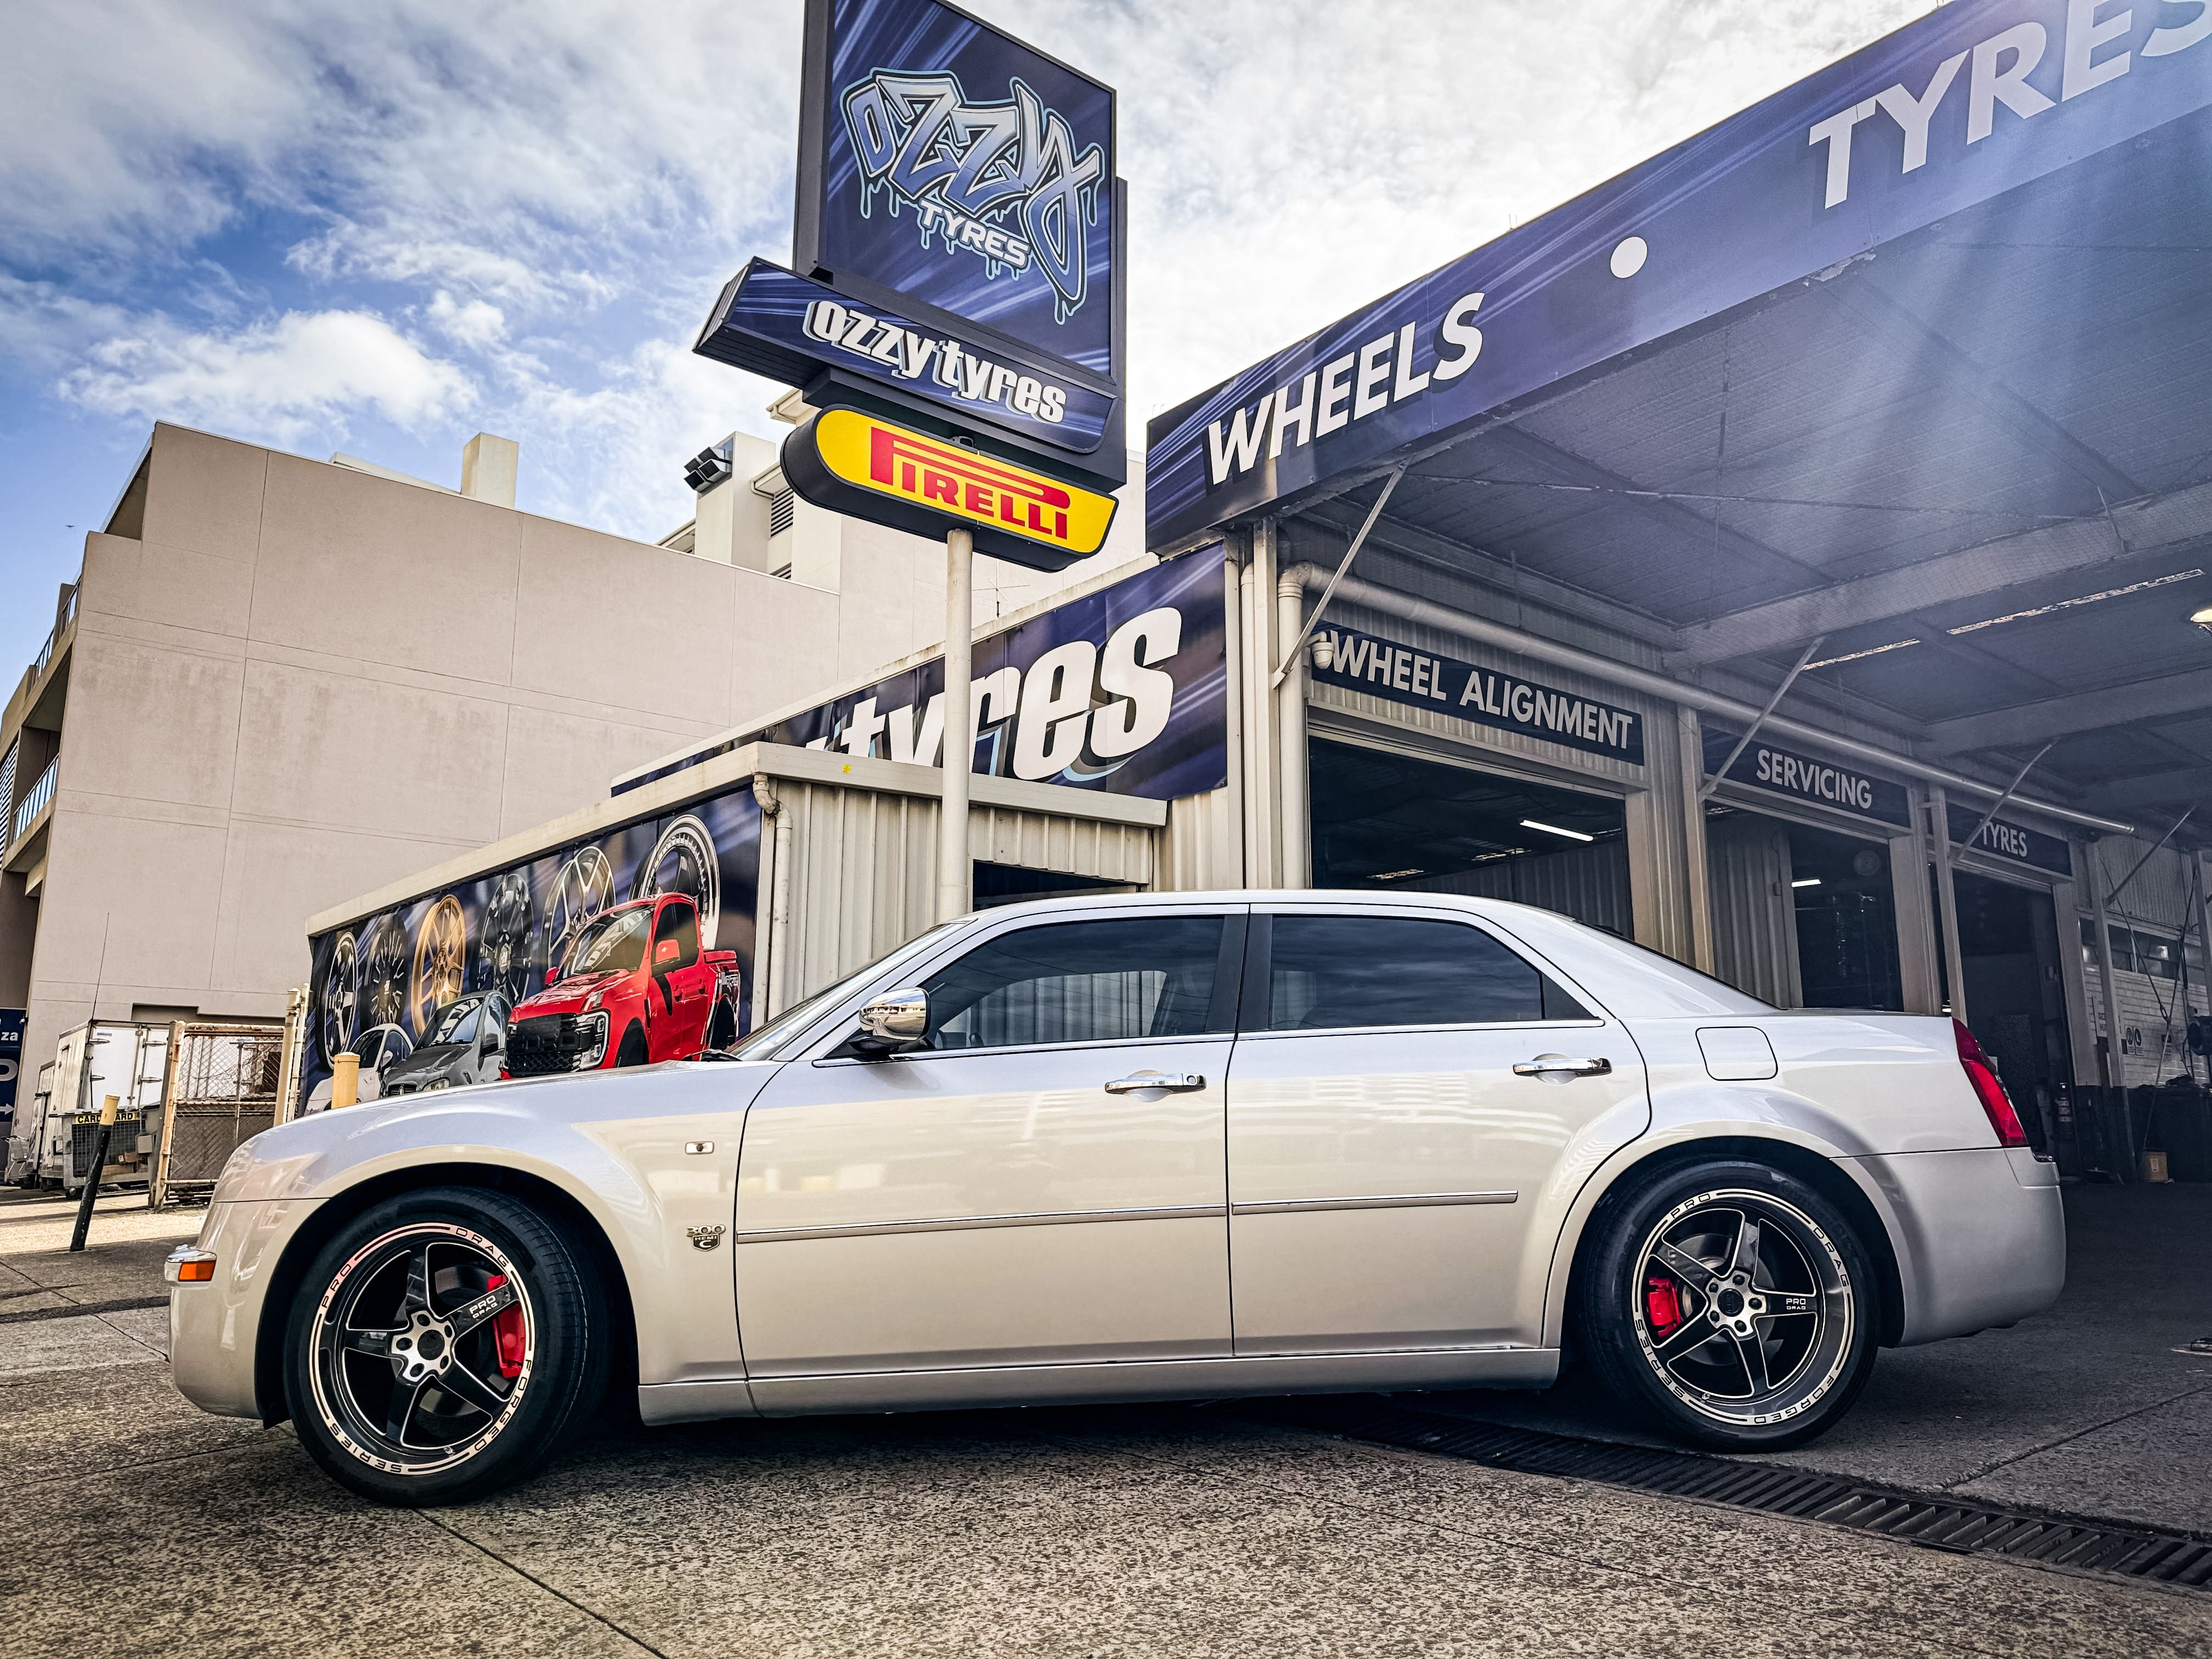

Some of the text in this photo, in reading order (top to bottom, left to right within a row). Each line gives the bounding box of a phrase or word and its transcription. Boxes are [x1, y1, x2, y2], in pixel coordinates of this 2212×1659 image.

[919, 198, 1031, 268] TYRES
[809, 300, 1067, 424] ozzy tyres
[1207, 292, 1485, 486] WHEELS
[870, 426, 1071, 540] PIRELLI
[1330, 630, 1633, 749] WHEEL ALIGNMENT
[1756, 749, 1872, 809] SERVICING
[1979, 819, 2027, 857] TYRES
[77, 1113, 133, 1124] CARDARD
[321, 1227, 509, 1308] PRO DRAG
[686, 1224, 726, 1237] 300
[1670, 1193, 1849, 1288] PRO DRAG
[470, 1295, 496, 1314] PRO
[472, 1302, 498, 1318] DRAG
[1635, 1319, 1835, 1424] FORGED SERIES
[329, 1359, 532, 1473] FORGED SERIES
